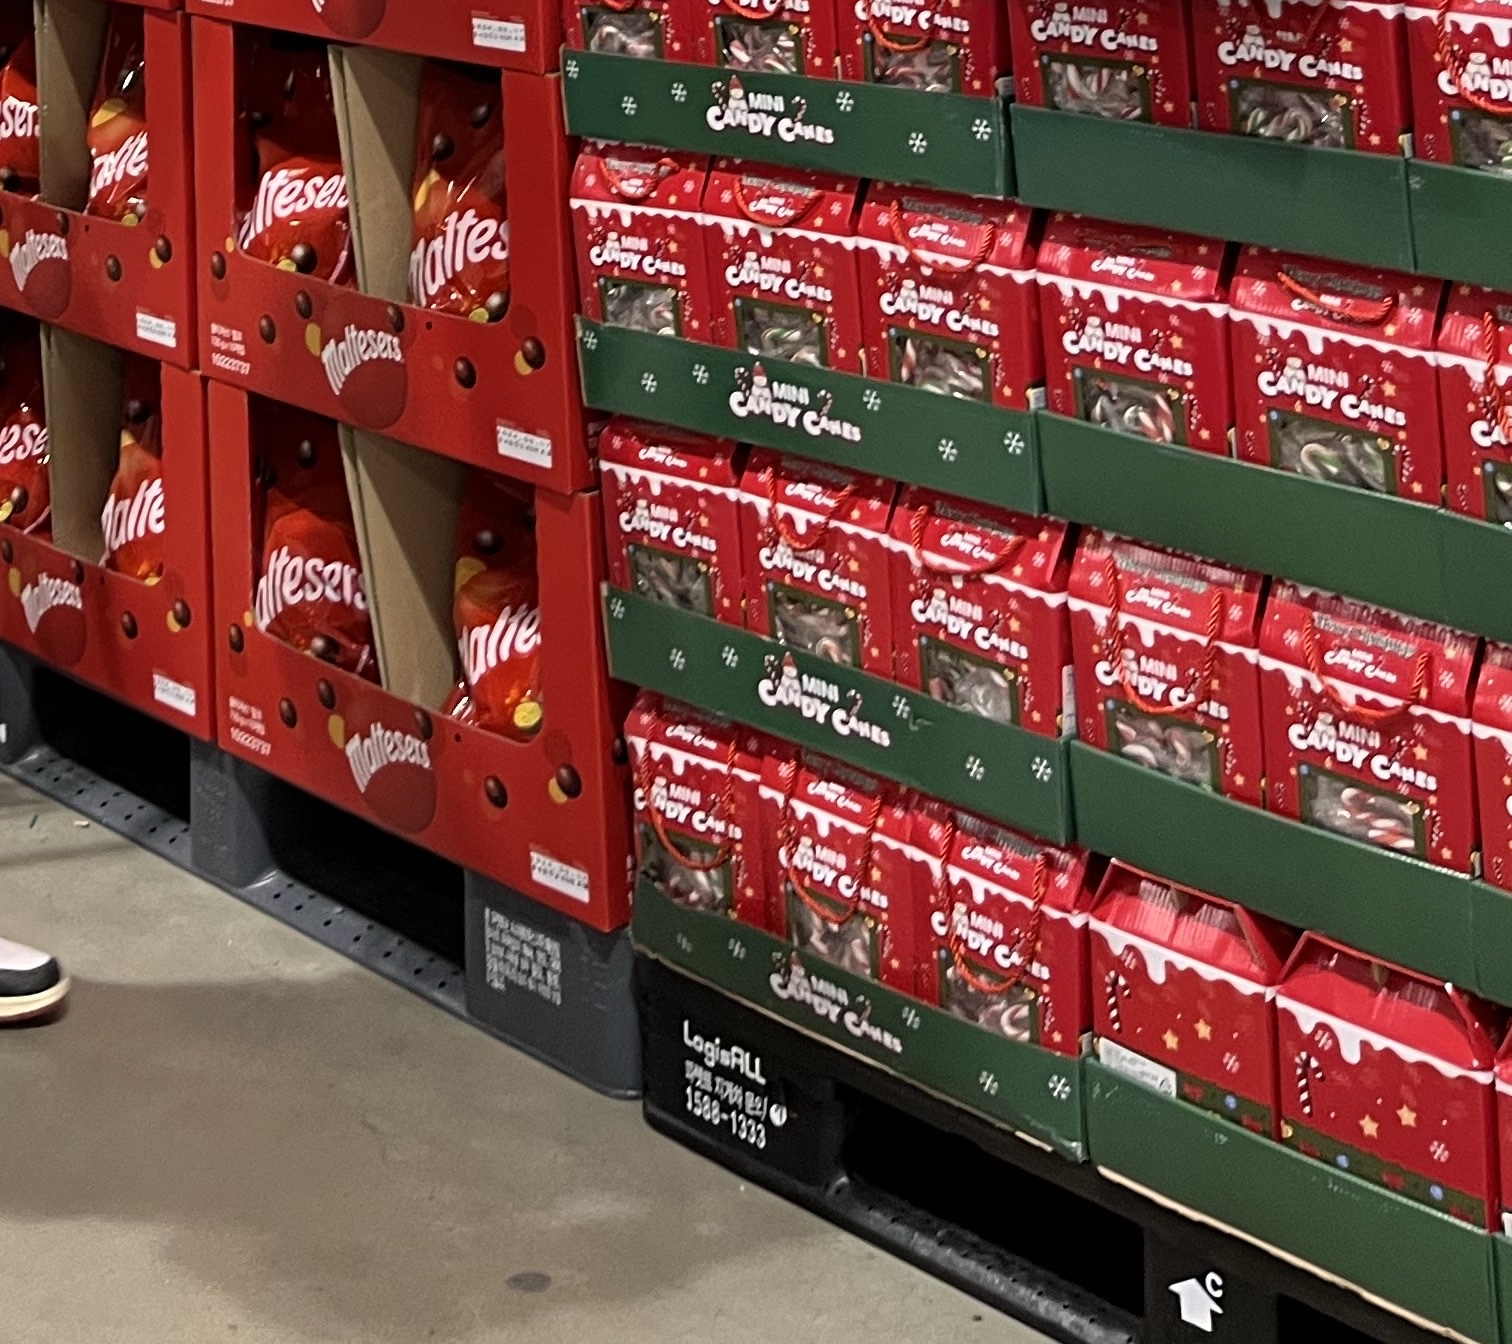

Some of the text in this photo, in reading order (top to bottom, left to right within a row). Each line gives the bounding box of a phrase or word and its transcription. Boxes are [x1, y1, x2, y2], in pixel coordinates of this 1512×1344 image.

[1030, 19, 1099, 45] CANDY
[1217, 40, 1296, 71] CANDY
[706, 105, 776, 136] CANDY
[409, 208, 509, 308] Maltes
[589, 245, 642, 271] CANDY
[725, 265, 784, 293] CANDY
[879, 292, 945, 323] CANDY
[322, 325, 404, 395] Maltesers
[1062, 330, 1132, 364] CANDY
[1257, 371, 1338, 410] CANDY
[729, 391, 802, 427] CANDY
[618, 511, 672, 540] CANDY
[759, 546, 818, 583] CANDY
[911, 599, 974, 641] CANDY
[758, 678, 831, 725] CANDY
[345, 722, 431, 794] Maltesers
[1288, 723, 1370, 769] CANDY
[683, 1019, 767, 1085] LogisALL
